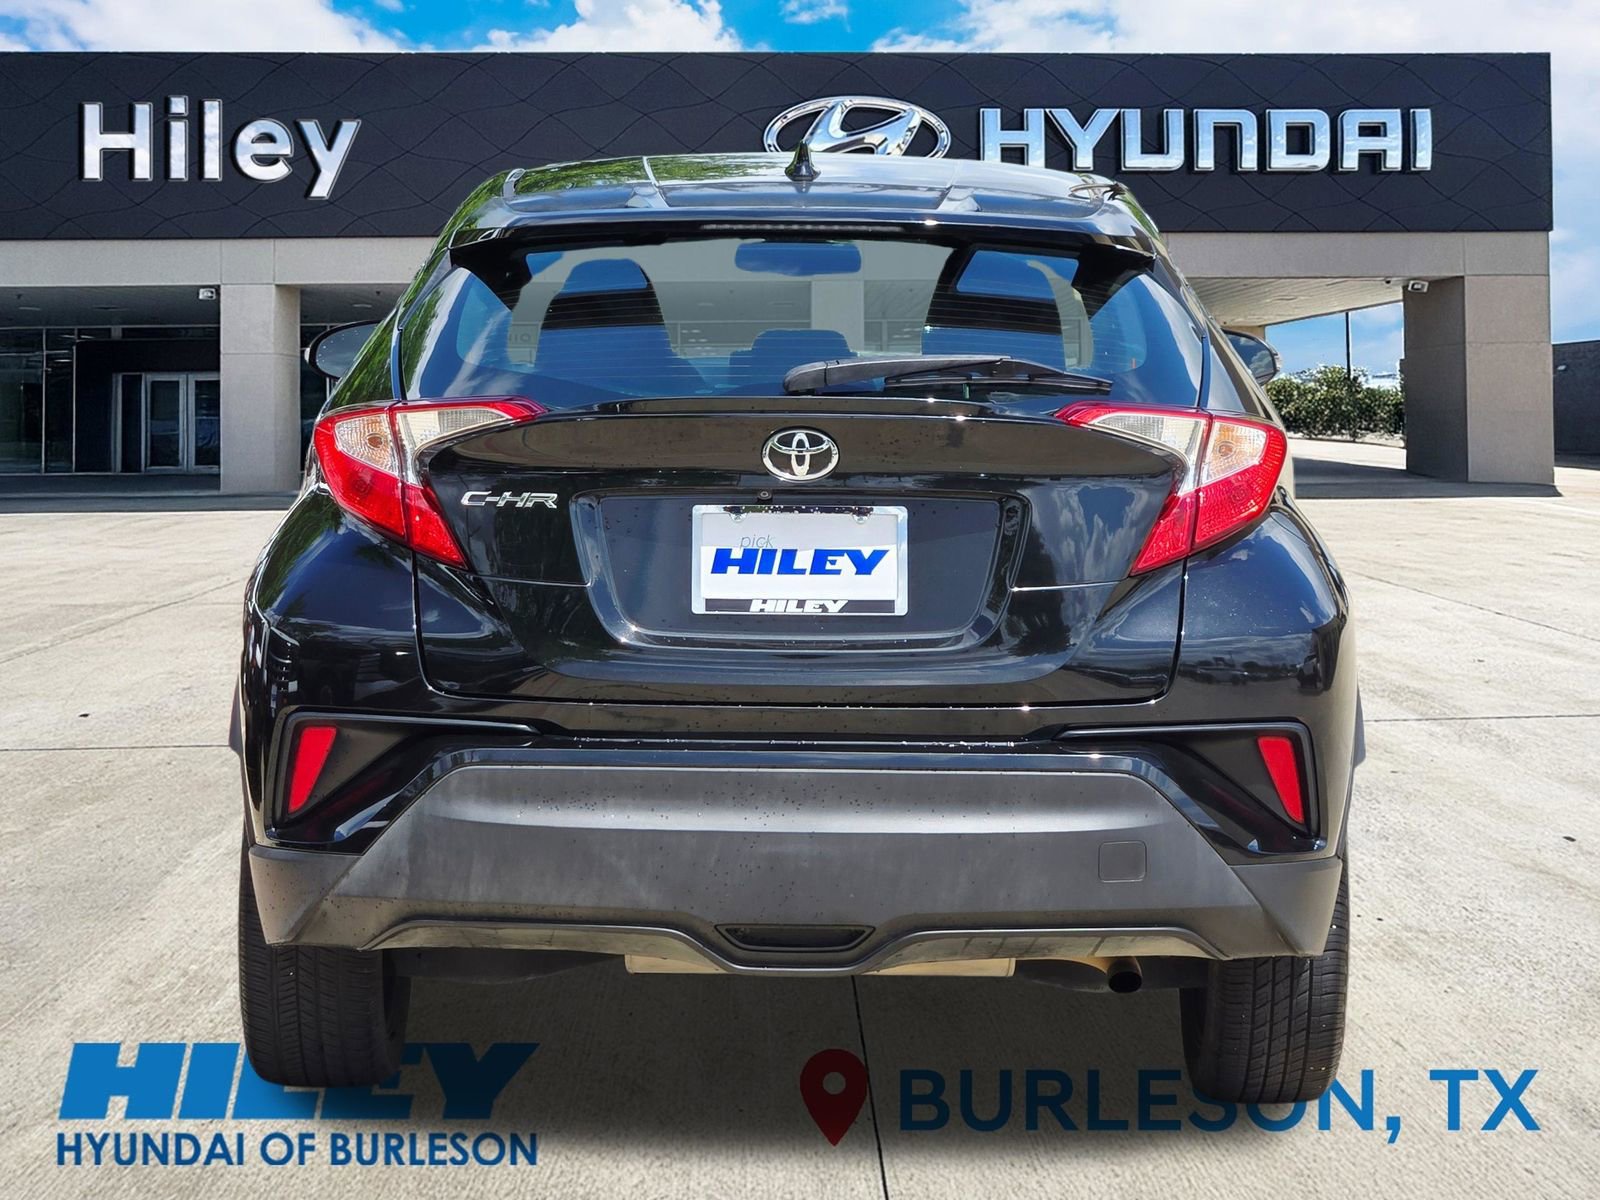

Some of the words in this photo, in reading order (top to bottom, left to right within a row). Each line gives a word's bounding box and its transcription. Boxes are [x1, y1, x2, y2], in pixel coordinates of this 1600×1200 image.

[80, 95, 362, 200] Hiley
[979, 107, 1433, 172] HYUNDAI
[460, 490, 558, 509] C-HR
[739, 533, 775, 548] pick
[711, 548, 889, 575] HILEY
[749, 599, 849, 613] HILEY
